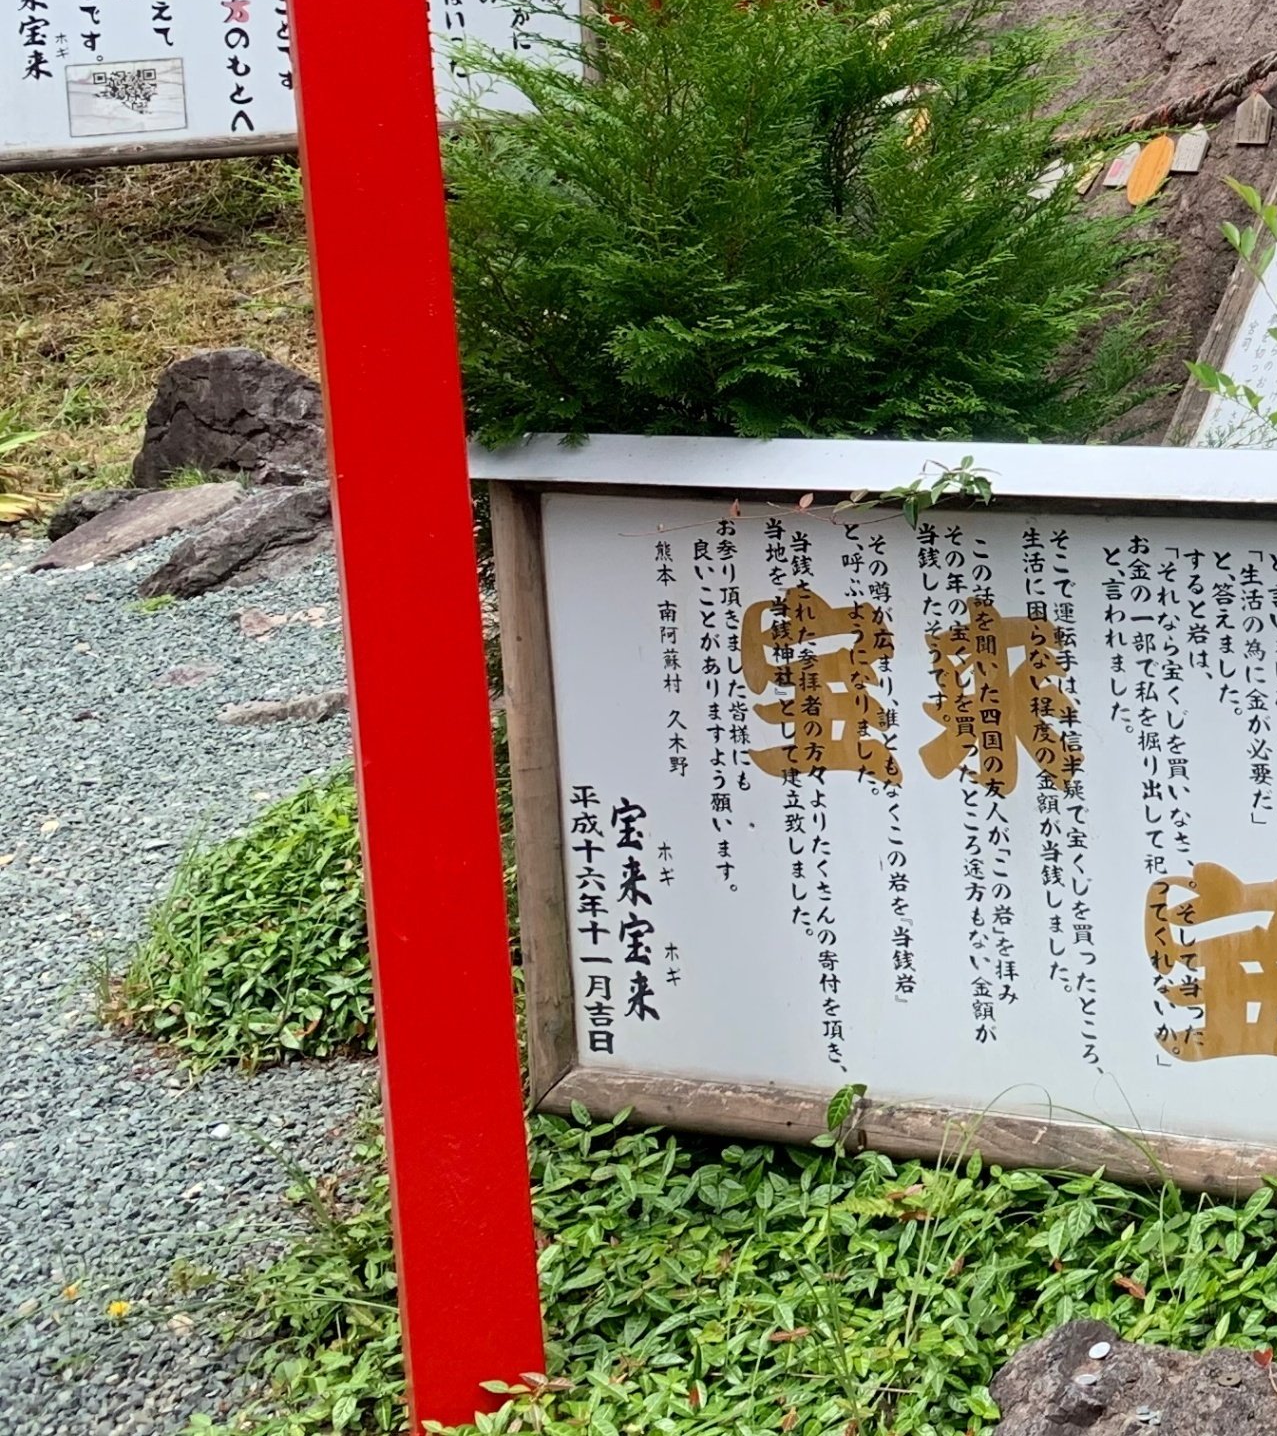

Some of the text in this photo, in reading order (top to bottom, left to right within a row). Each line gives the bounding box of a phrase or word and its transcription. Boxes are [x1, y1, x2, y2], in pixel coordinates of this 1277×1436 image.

[55, 32, 69, 59] ホギ
[655, 541, 689, 777] 熊本 南阿蘇村 久木野
[716, 517, 751, 792] お参り頂きました皆様にも
[841, 523, 880, 796] と、呼ぶようになりました。
[916, 523, 951, 723] 当銭したそうです。
[1102, 547, 1134, 734] と、言われました。
[1183, 549, 1213, 679] すると岩は、
[1212, 550, 1243, 716] と、答えました。
[693, 539, 738, 892] 良いことがありますよう願います。
[570, 785, 615, 1054] 平成十六年十一月吉日
[611, 797, 660, 1021] 宝来宝来
[657, 841, 675, 886] ホギ
[664, 942, 681, 986] ホギ
